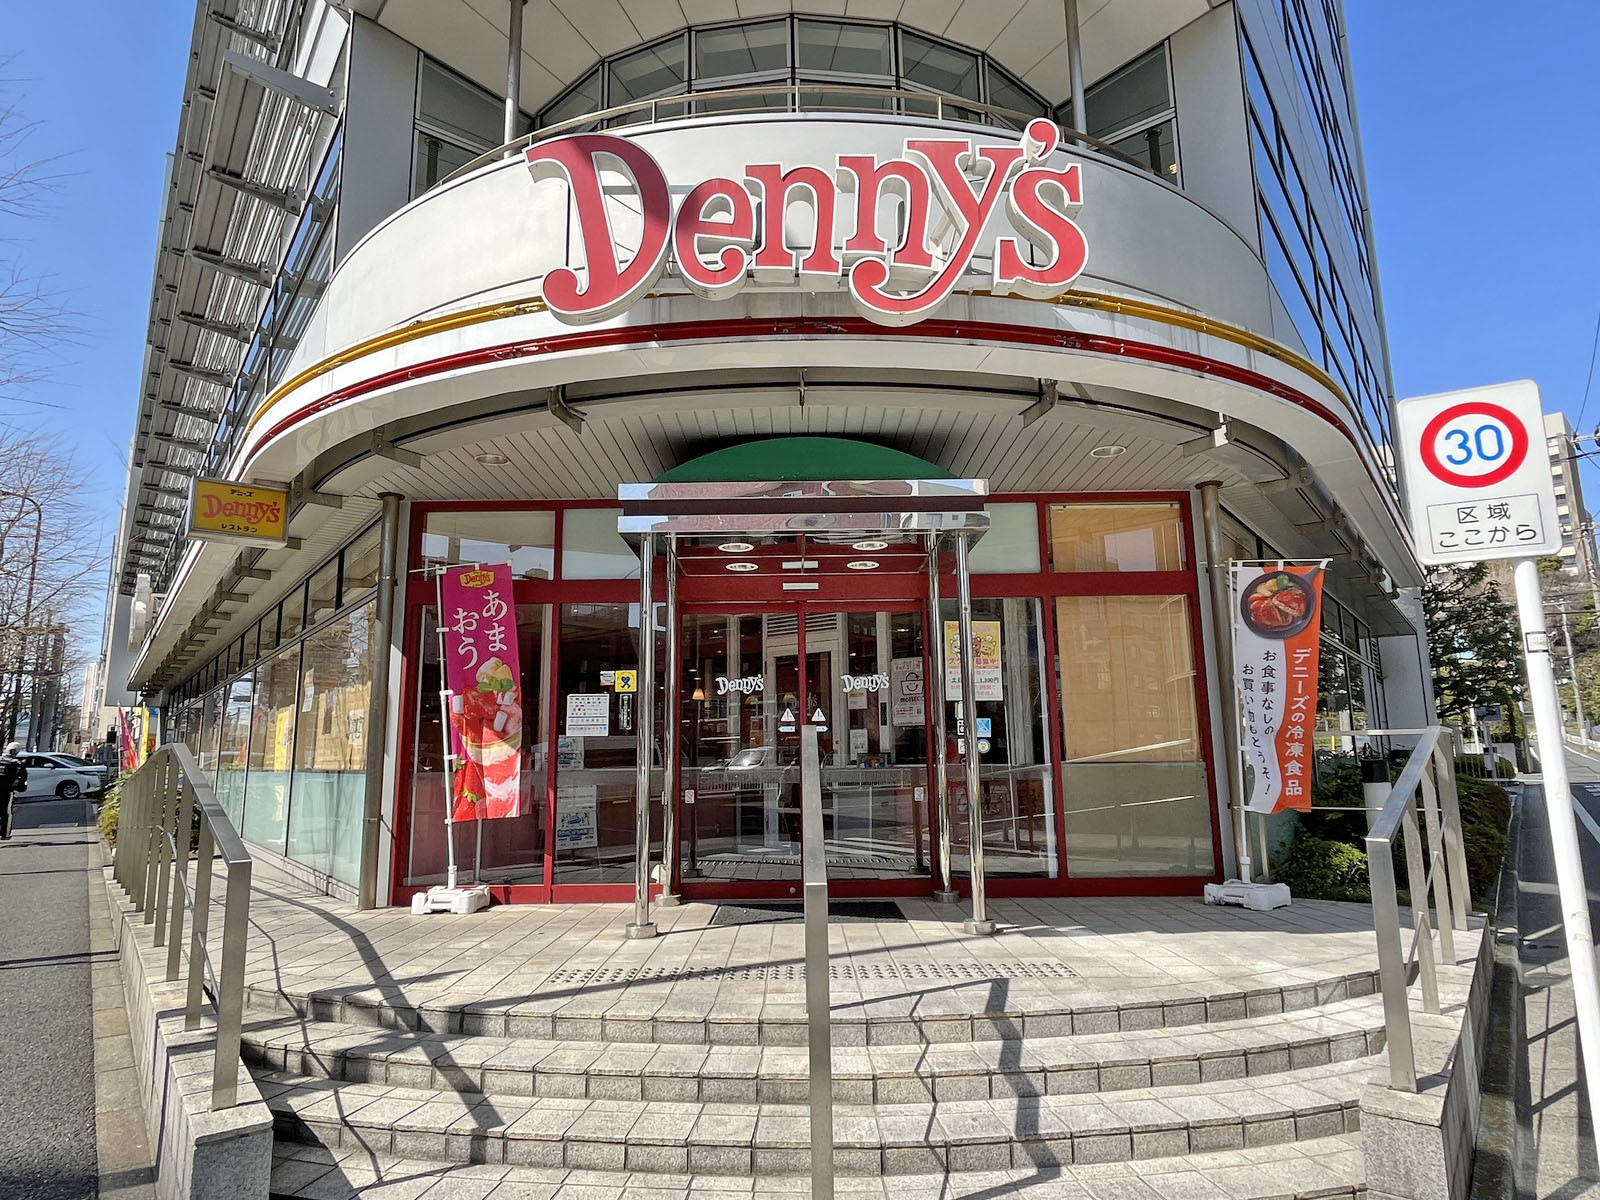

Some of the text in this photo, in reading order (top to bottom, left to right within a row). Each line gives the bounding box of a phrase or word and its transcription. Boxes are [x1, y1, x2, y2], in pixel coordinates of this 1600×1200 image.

[524, 118, 1086, 322] Denny's
[1445, 425, 1504, 465] 30
[202, 494, 280, 525] Denny's
[1457, 503, 1511, 524] 区域
[221, 523, 257, 533] レストラン
[1440, 524, 1537, 549] ここから
[482, 589, 508, 652] あま
[452, 607, 480, 670] おう
[715, 673, 764, 695] Denny's
[840, 672, 890, 693] Denny's
[1260, 650, 1277, 735] お食事なしの
[1284, 647, 1312, 796] デニーズの冷凍食品
